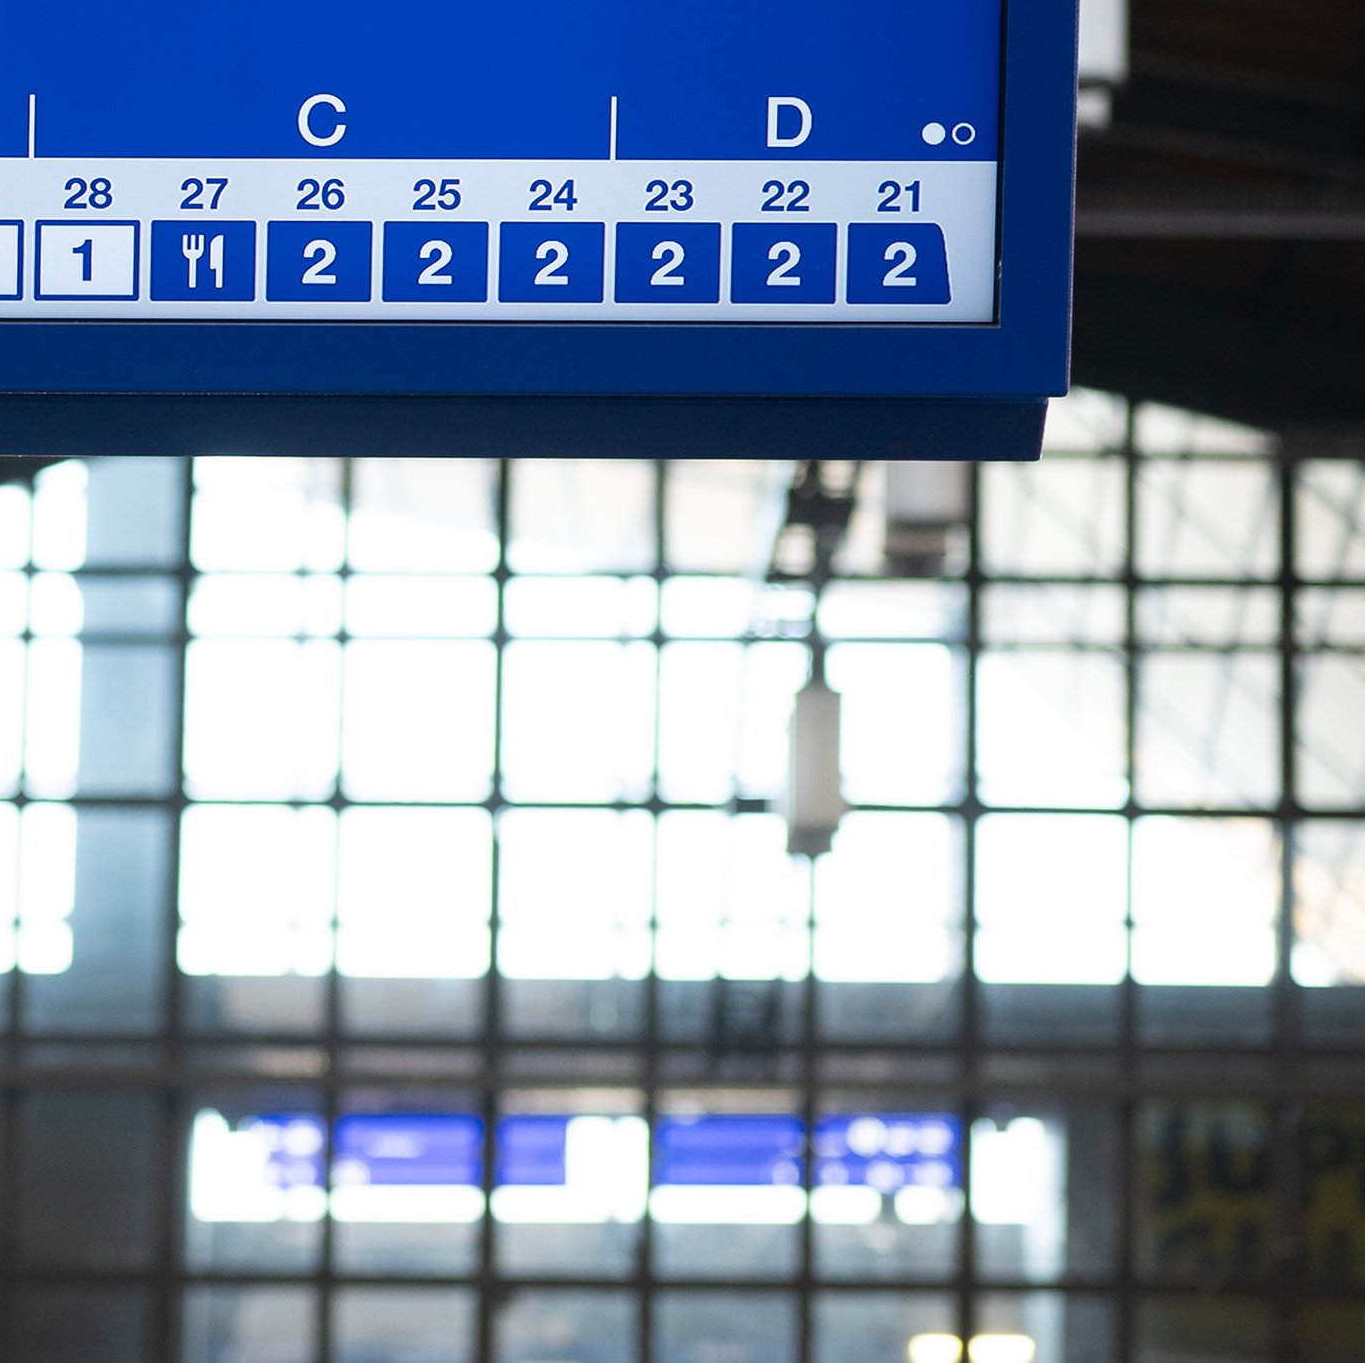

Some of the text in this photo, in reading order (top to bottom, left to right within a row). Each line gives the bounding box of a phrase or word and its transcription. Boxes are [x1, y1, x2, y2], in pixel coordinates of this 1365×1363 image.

[297, 93, 347, 147] C
[766, 96, 812, 148] D
[62, 177, 114, 210] 28
[178, 177, 230, 210] 27
[294, 178, 346, 211] 26
[411, 178, 463, 211] 25
[527, 179, 579, 212] 24
[643, 179, 695, 212] 23
[759, 179, 812, 212] 22
[875, 179, 922, 213] 21
[71, 238, 94, 282] 1
[300, 239, 338, 284] 2
[417, 240, 454, 285] 2
[533, 240, 570, 285] 2
[649, 240, 686, 286] 2
[765, 241, 802, 286] 2
[881, 241, 918, 287] 2
